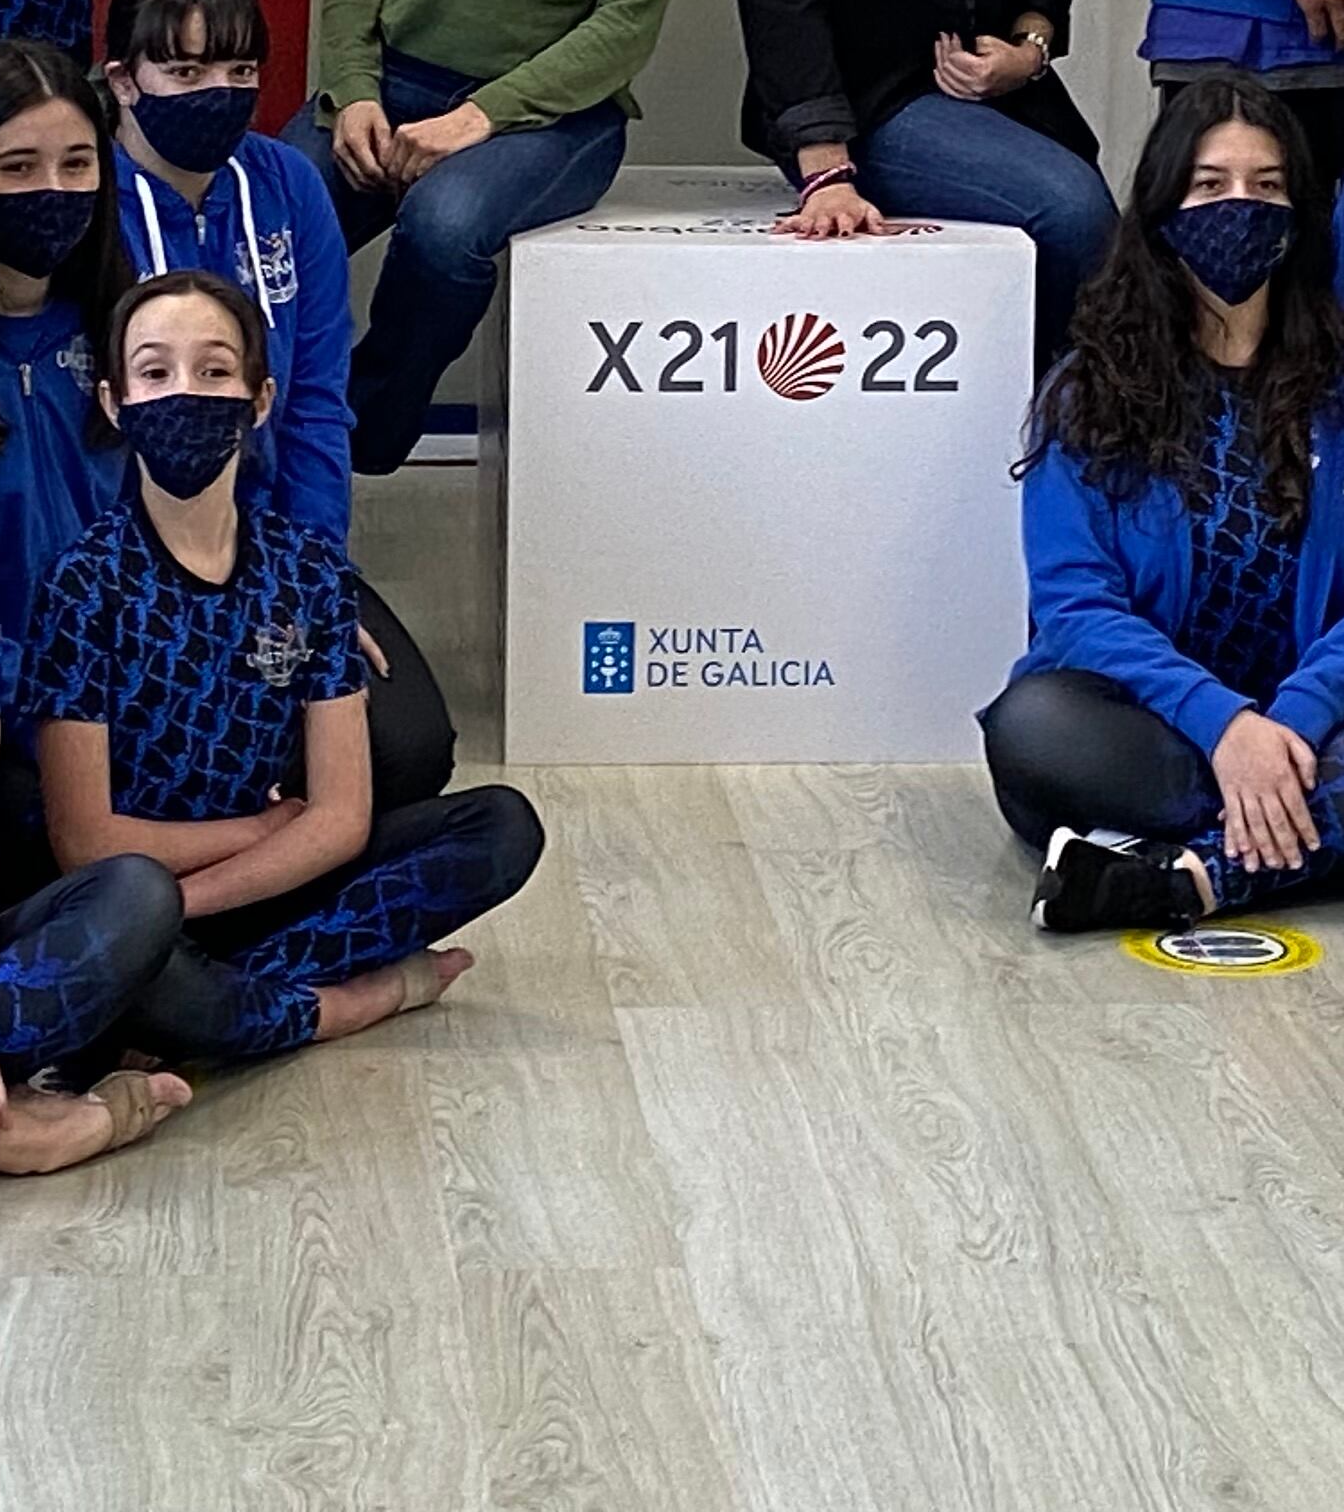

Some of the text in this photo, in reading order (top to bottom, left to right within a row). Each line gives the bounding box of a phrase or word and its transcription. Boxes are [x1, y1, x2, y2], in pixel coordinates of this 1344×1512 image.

[861, 320, 959, 392] 22
[649, 628, 764, 654] XUNTA
[647, 660, 836, 688] DE GALICIA
